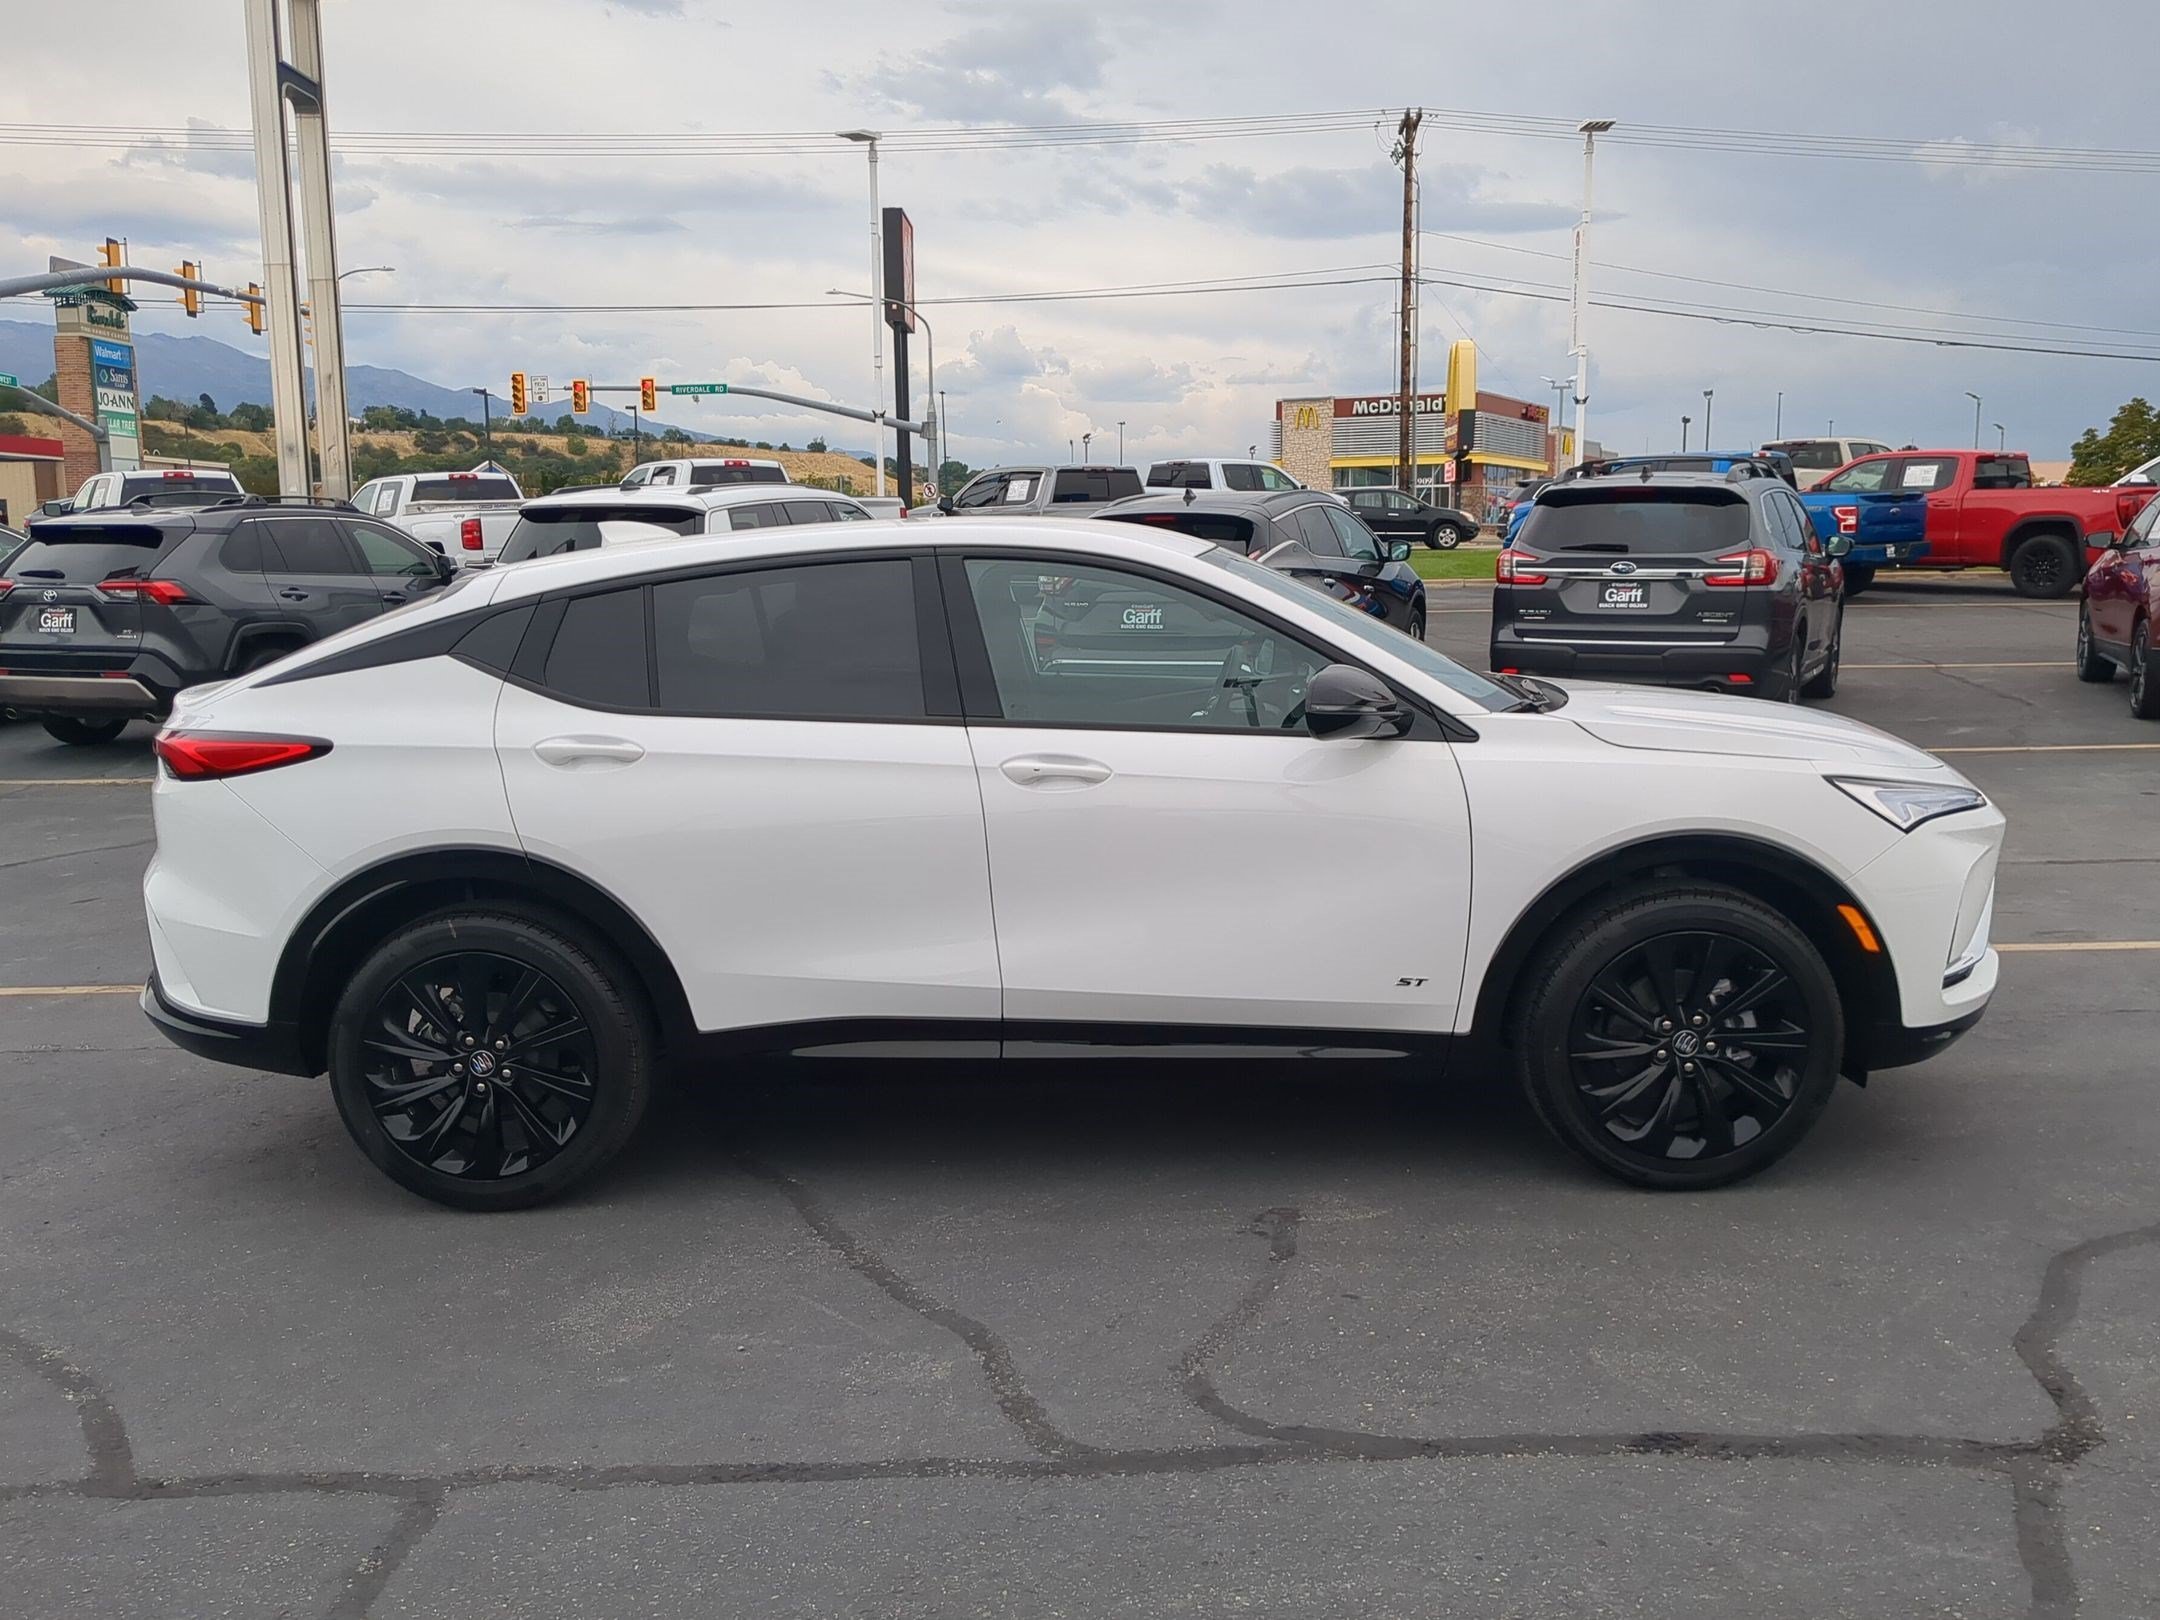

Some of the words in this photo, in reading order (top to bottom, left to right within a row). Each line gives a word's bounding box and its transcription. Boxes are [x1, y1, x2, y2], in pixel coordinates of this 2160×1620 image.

[94, 345, 122, 361] Walmart
[675, 386, 711, 394] RIVERDALE
[715, 385, 724, 393] RD
[1604, 588, 1643, 602] Garff
[40, 612, 73, 628] Garff
[1122, 608, 1162, 624] Garff
[1396, 977, 1429, 987] ST
